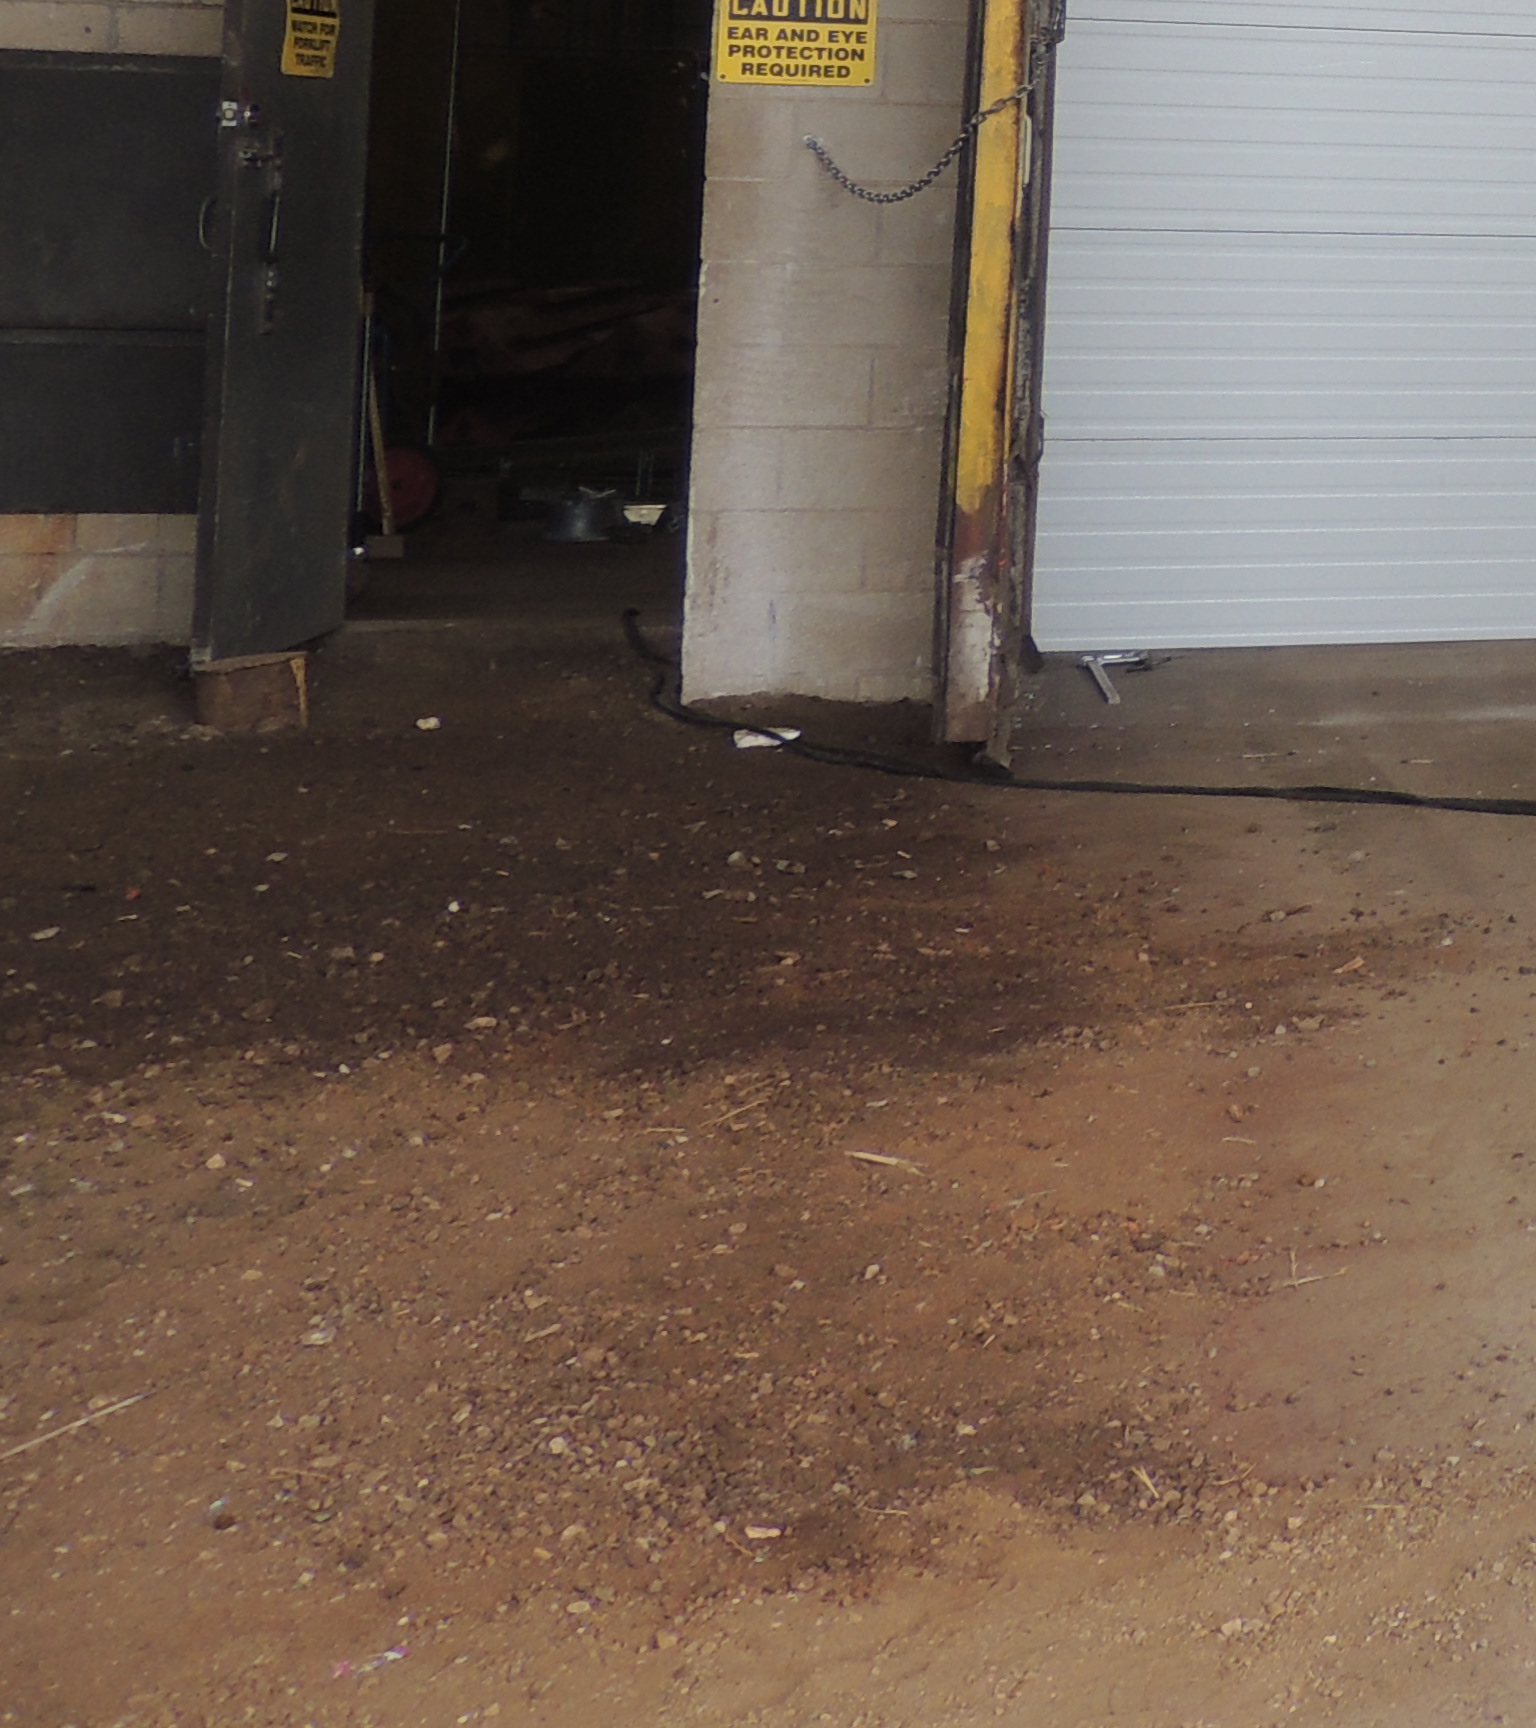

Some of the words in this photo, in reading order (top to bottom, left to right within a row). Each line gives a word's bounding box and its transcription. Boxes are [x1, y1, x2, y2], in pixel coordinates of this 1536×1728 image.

[320, 22, 336, 36] FOR
[727, 27, 768, 40] EAR
[775, 28, 820, 42] AND
[827, 30, 868, 44] EYE
[294, 37, 331, 51] FORKLIFT
[295, 53, 327, 67] TRAFFIC
[728, 45, 865, 61] PROTECTION
[741, 62, 851, 78] REQUIRED
